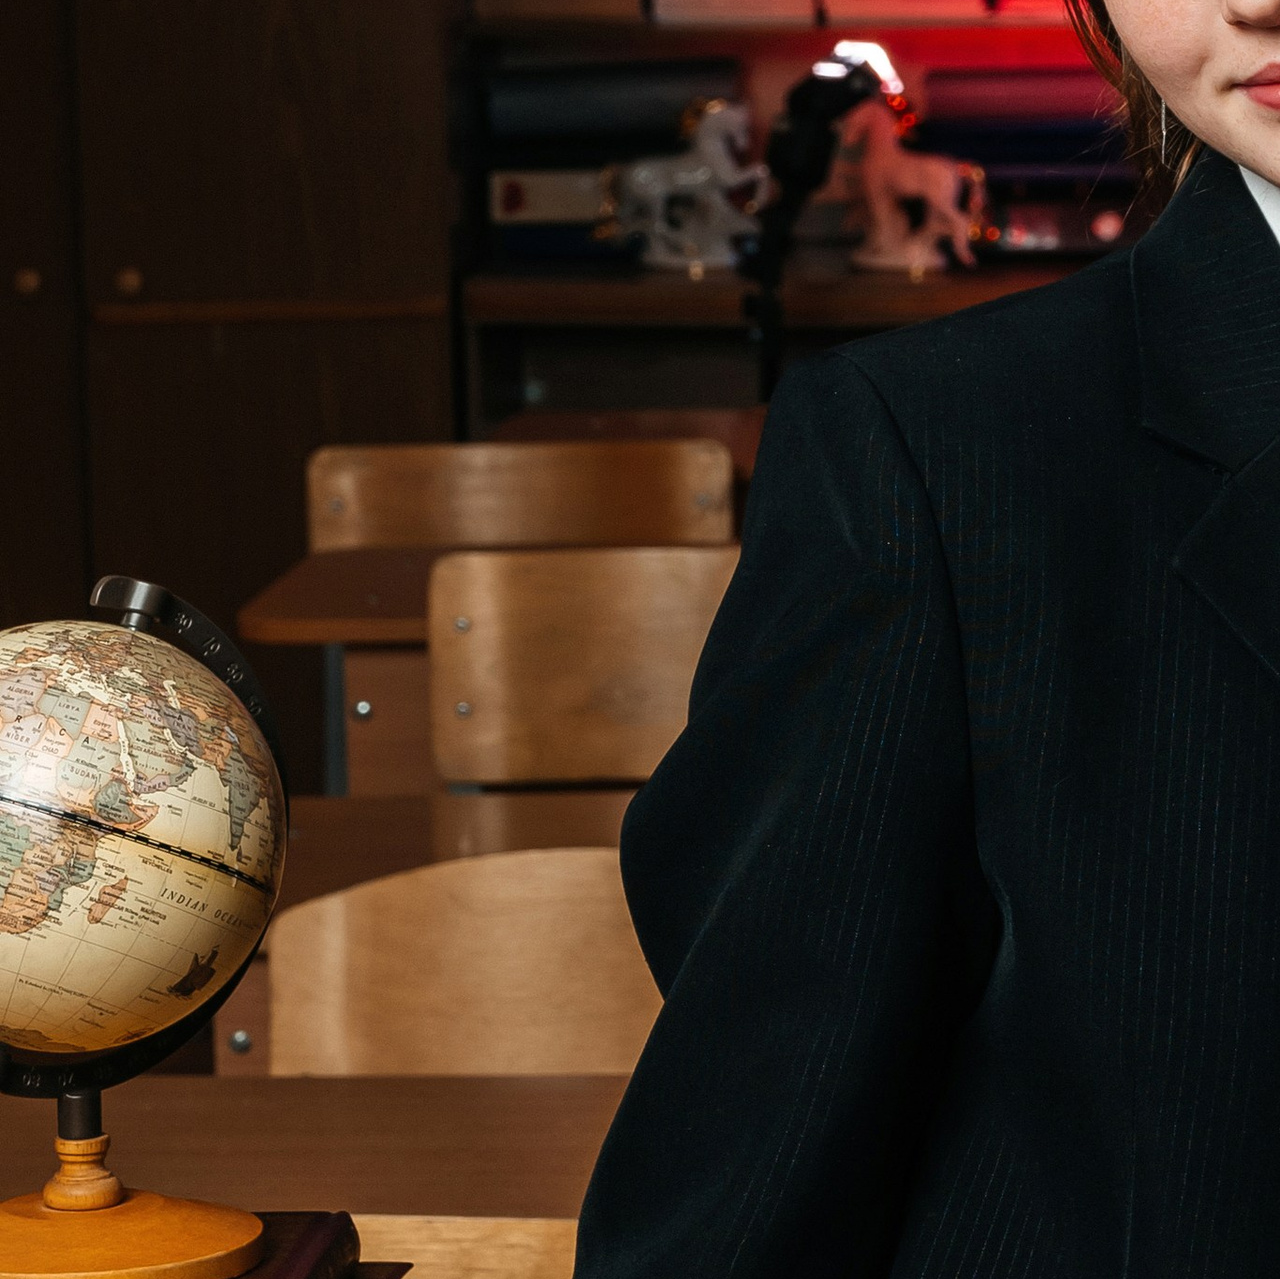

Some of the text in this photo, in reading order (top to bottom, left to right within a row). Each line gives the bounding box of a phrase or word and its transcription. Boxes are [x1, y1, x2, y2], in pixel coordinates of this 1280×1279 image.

[7, 685, 34, 696] ALGERIA
[58, 702, 80, 712] LIBYA
[93, 719, 112, 729] EGYPT
[6, 732, 31, 743] NIGER
[41, 745, 60, 755] CHAD
[69, 765, 97, 780] SUDAN
[89, 896, 124, 912] MADAGASCAR
[160, 887, 208, 913] INDIAN
